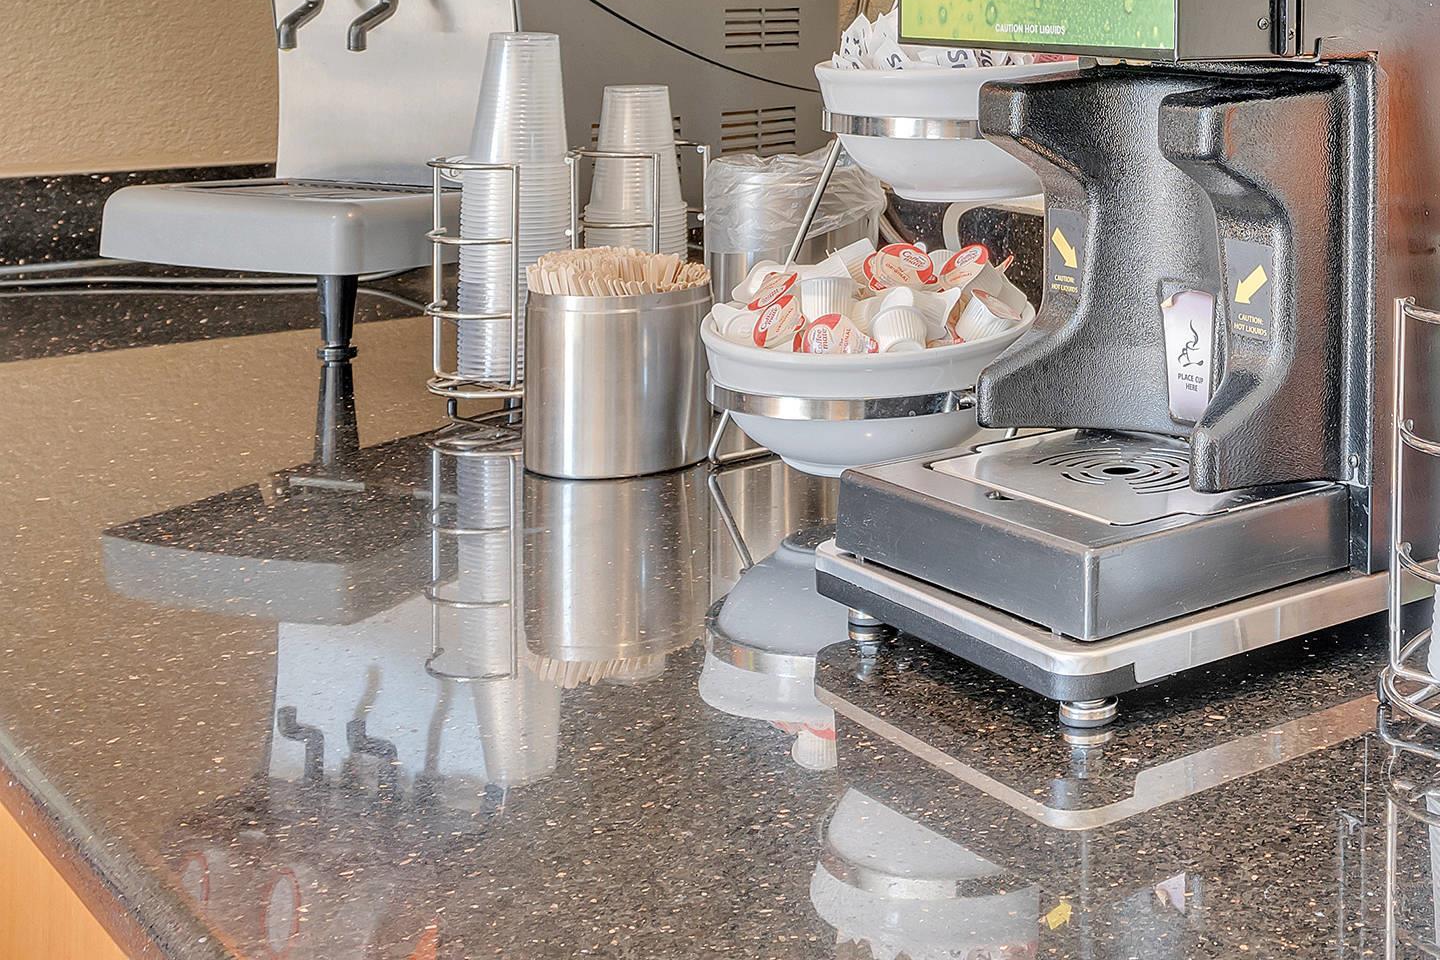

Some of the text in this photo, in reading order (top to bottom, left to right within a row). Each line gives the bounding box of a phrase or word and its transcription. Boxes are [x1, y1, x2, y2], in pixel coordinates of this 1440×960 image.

[995, 23, 1066, 36] CAUTION HOT LIQUIDS
[1233, 322, 1268, 337] HOT LIQUIDS
[1177, 372, 1204, 385] PLACE CUP
[1185, 382, 1199, 392] HERE
